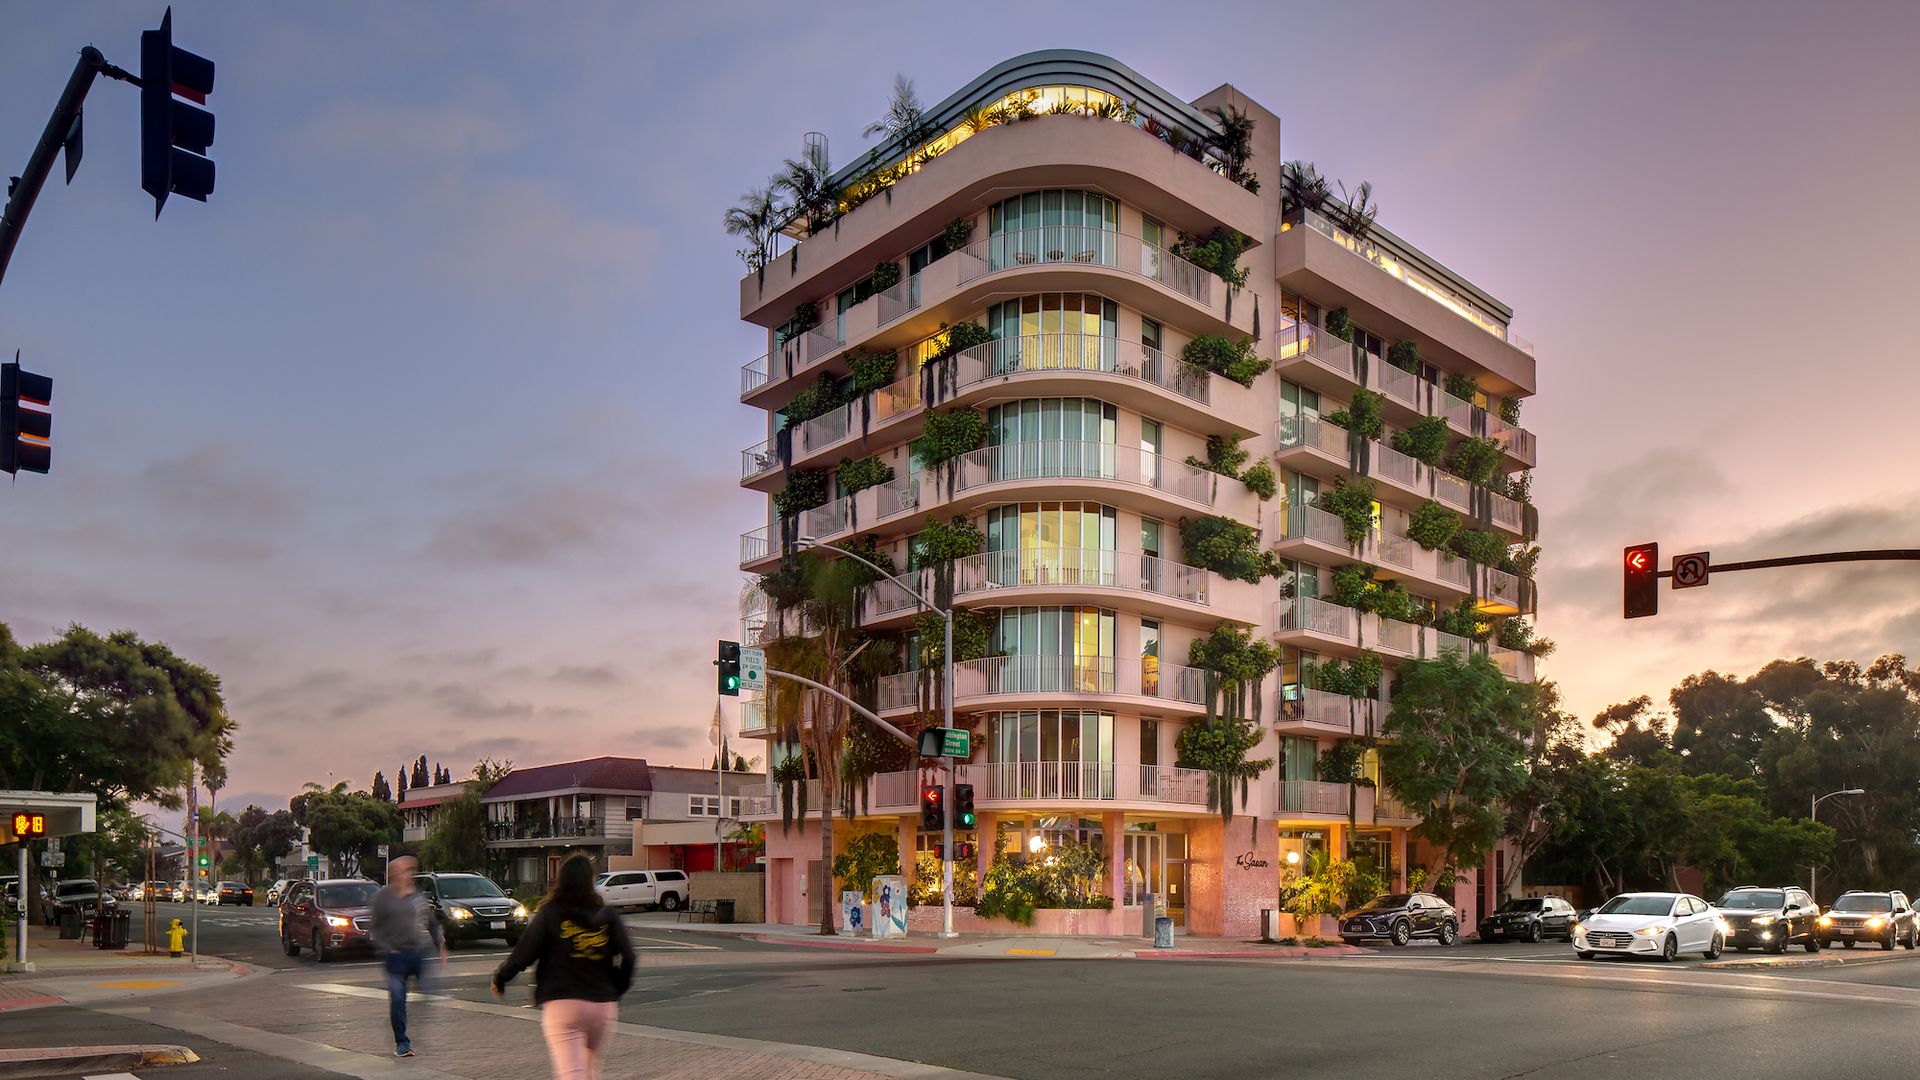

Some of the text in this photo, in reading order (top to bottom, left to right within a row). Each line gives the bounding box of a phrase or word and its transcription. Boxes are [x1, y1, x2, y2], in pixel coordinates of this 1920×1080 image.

[745, 656, 760, 664] YIELD
[945, 731, 967, 740] shington
[945, 739, 960, 747] Street
